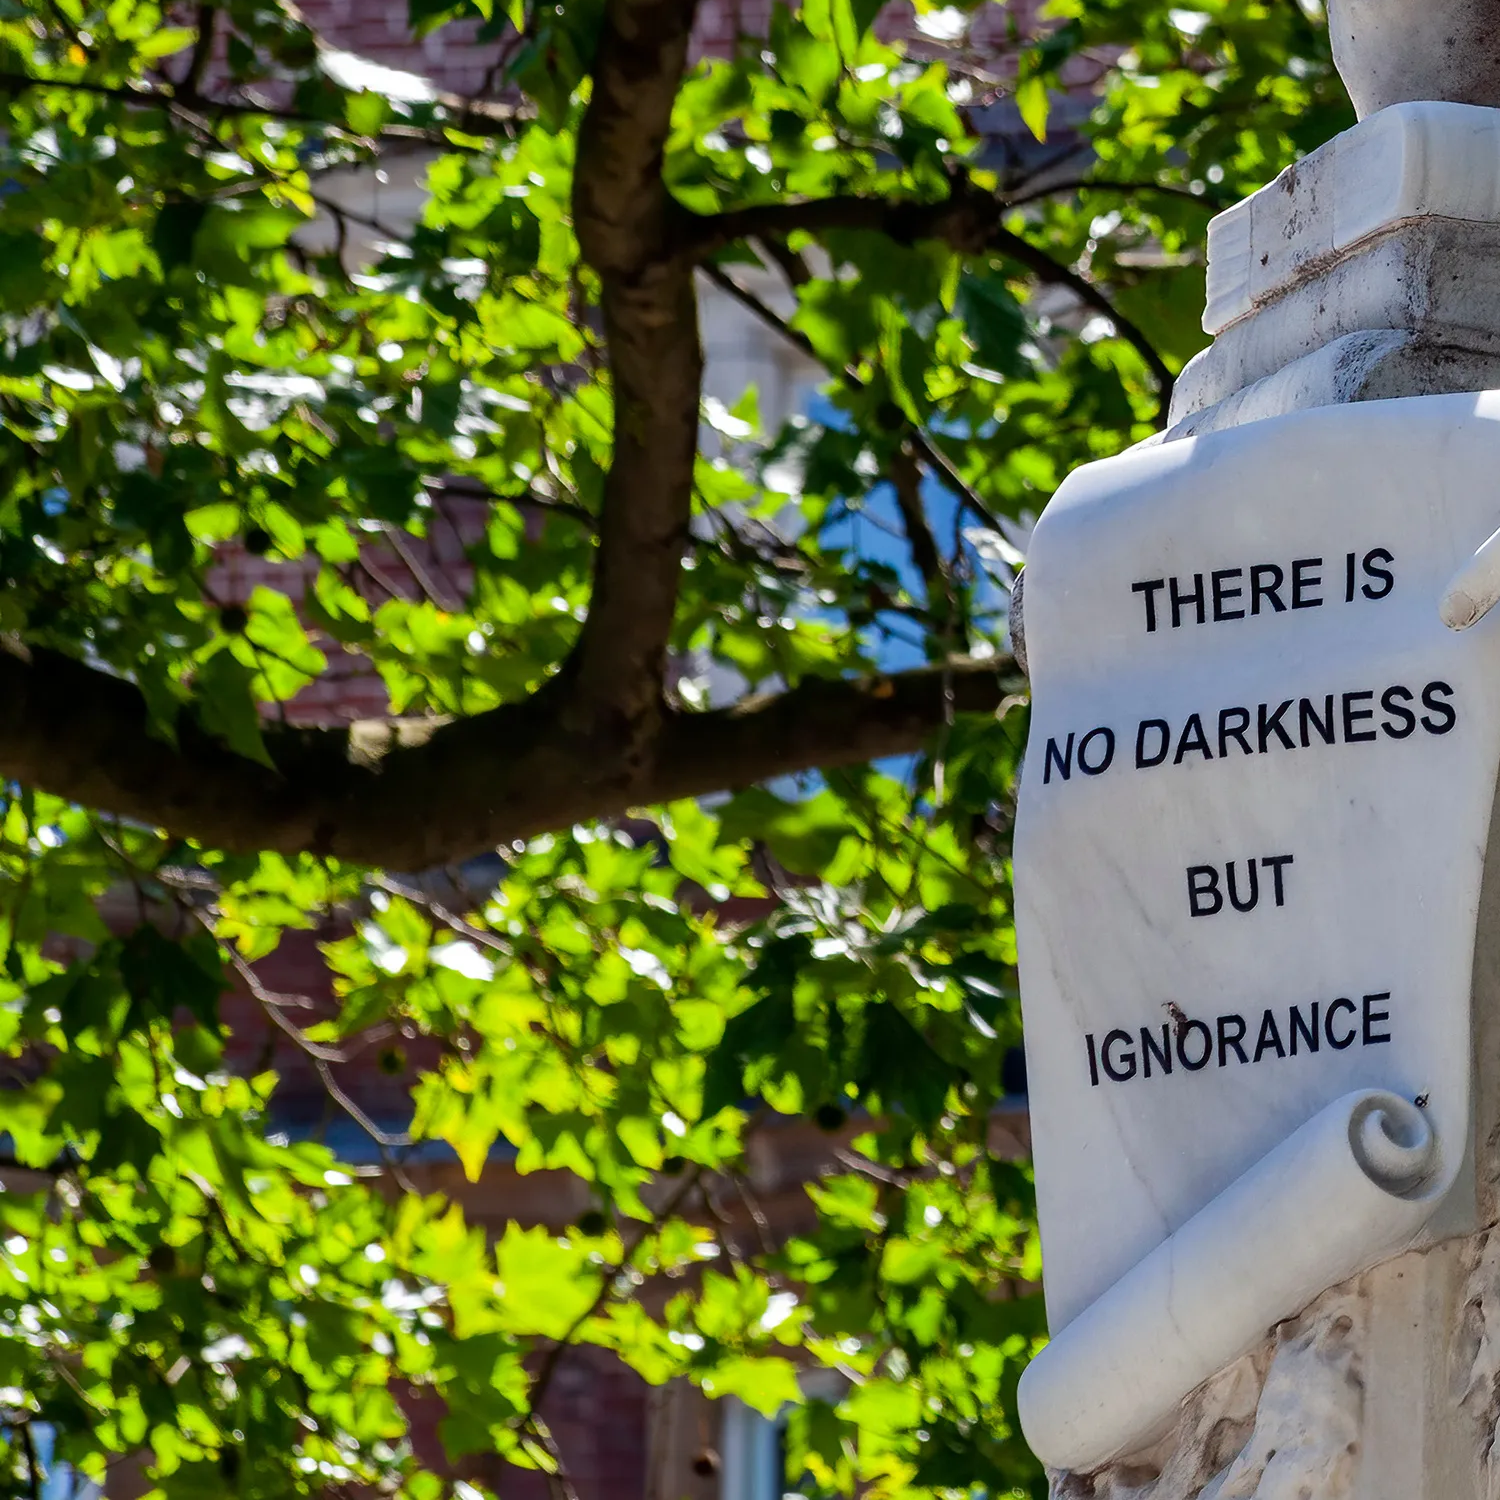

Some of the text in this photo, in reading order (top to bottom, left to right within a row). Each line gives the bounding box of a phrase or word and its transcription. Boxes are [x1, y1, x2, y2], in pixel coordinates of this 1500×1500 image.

[1131, 547, 1395, 633] THERE IS
[1043, 681, 1457, 785] NO DARKNESS
[1186, 854, 1294, 918] BUT
[1084, 991, 1391, 1087] IGNORANCE
